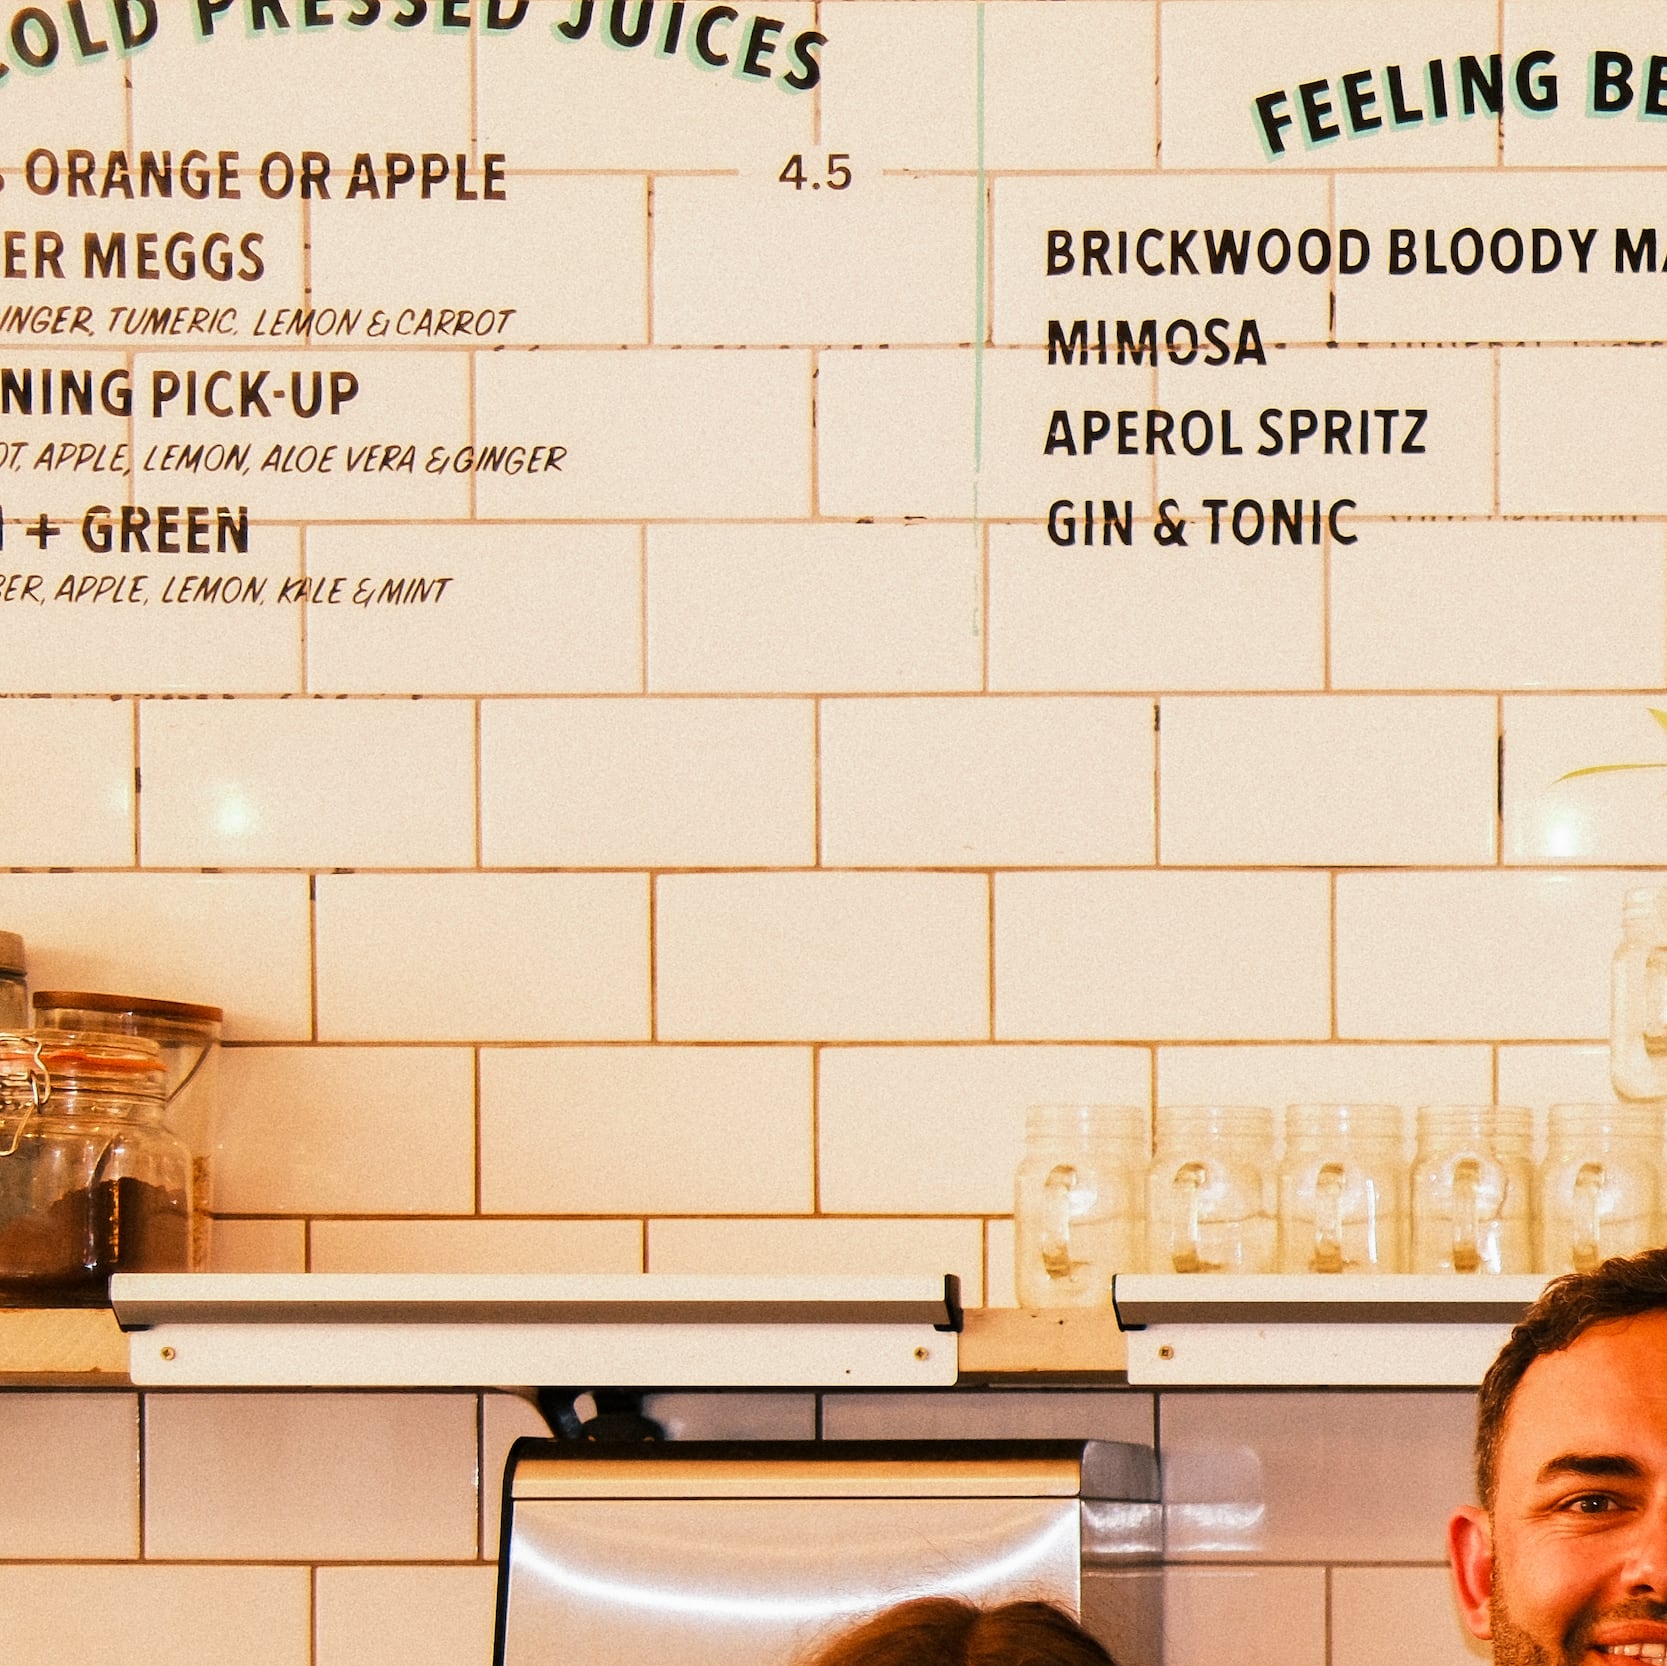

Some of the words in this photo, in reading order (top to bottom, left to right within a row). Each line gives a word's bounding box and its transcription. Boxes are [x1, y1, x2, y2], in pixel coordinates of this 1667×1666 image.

[0, 0, 157, 78] OLD
[558, 0, 827, 90] JUICES
[1254, 51, 1558, 156] FEELING
[27, 150, 240, 199] ORANGE
[260, 152, 330, 199] OR
[346, 154, 505, 200] APPLE
[780, 155, 851, 189] 4.5
[85, 232, 264, 281] MEGGS
[1047, 229, 1370, 276] BRICKWOOD
[1389, 228, 1597, 275] BLOODY
[254, 309, 361, 336] LEMON
[368, 311, 389, 336] &
[397, 309, 515, 336] CARROT
[1048, 318, 1266, 367] MIMOSA
[154, 371, 358, 418] PICK-UP
[1044, 410, 1242, 456] APEROL
[1258, 409, 1427, 456] SPRITZ
[34, 443, 130, 475] APPLE,
[144, 445, 250, 475] LEMON,
[261, 445, 337, 472] ALOE
[348, 445, 415, 472] VERA
[426, 447, 449, 473] &
[454, 446, 566, 474] GINGER
[83, 506, 248, 553] GREEN
[1048, 500, 1132, 546] GIN
[1154, 499, 1187, 546] &
[1202, 499, 1357, 545] TONIC
[278, 578, 346, 603] KALE
[378, 578, 453, 604] MINT
